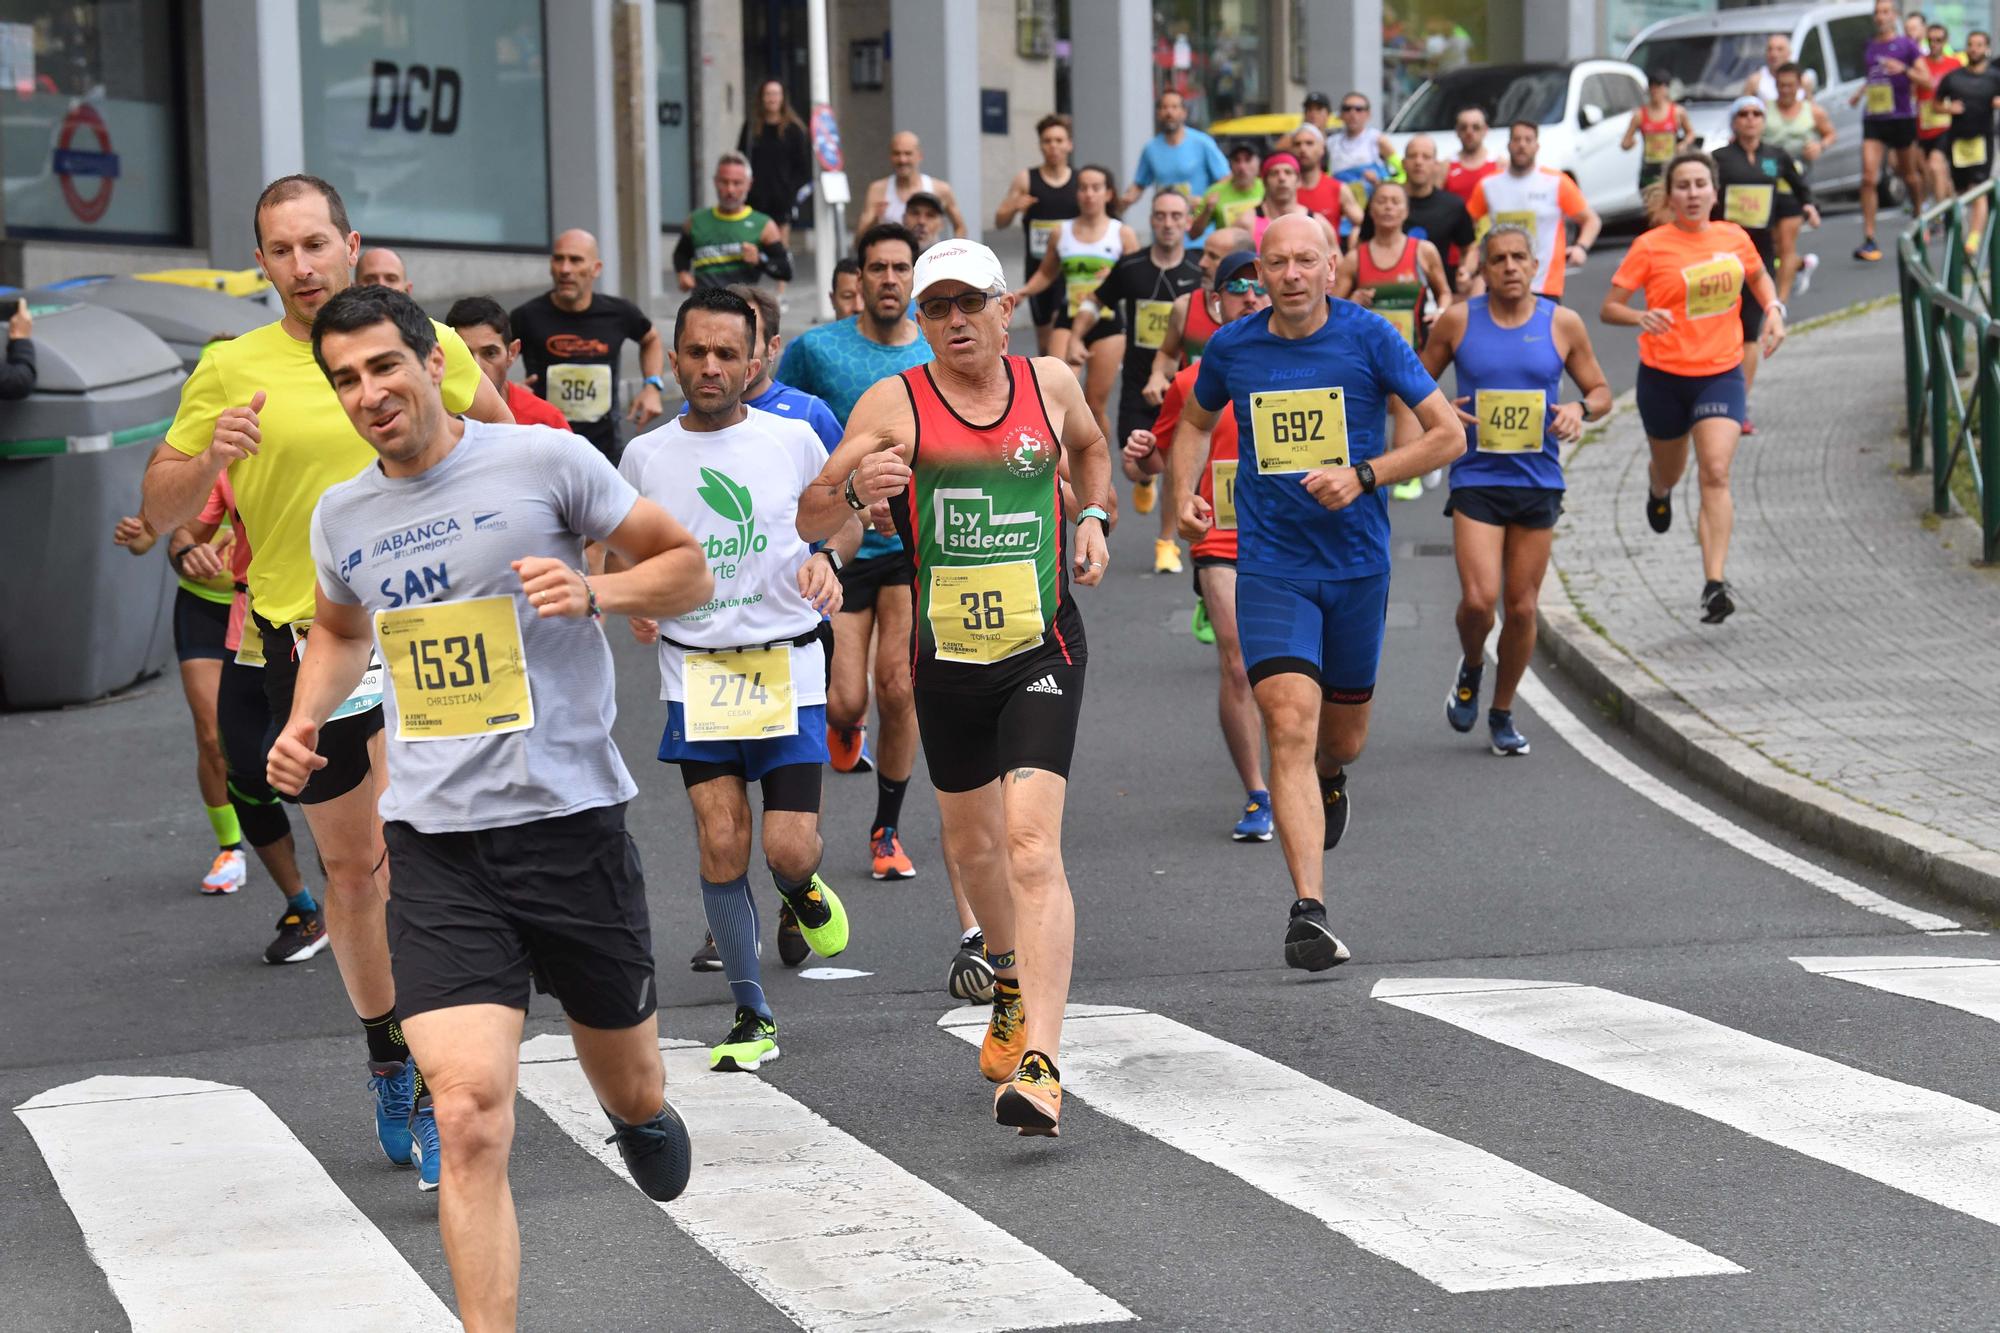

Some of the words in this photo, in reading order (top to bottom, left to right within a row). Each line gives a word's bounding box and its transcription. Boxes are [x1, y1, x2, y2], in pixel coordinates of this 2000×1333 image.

[369, 60, 462, 134] DCD
[659, 102, 682, 126] CD
[561, 379, 597, 401] 364
[1272, 410, 1325, 443] 692
[1490, 406, 1530, 430] 482
[950, 505, 980, 532] by
[712, 561, 736, 579] rte
[381, 563, 449, 607] SAN
[741, 593, 763, 605] PASO
[960, 591, 1005, 630] 36
[410, 633, 490, 690] 1531
[360, 676, 377, 685] NGO
[710, 671, 768, 707] 274
[1026, 684, 1063, 696] adidas
[426, 692, 483, 707] CHRISTIAN
